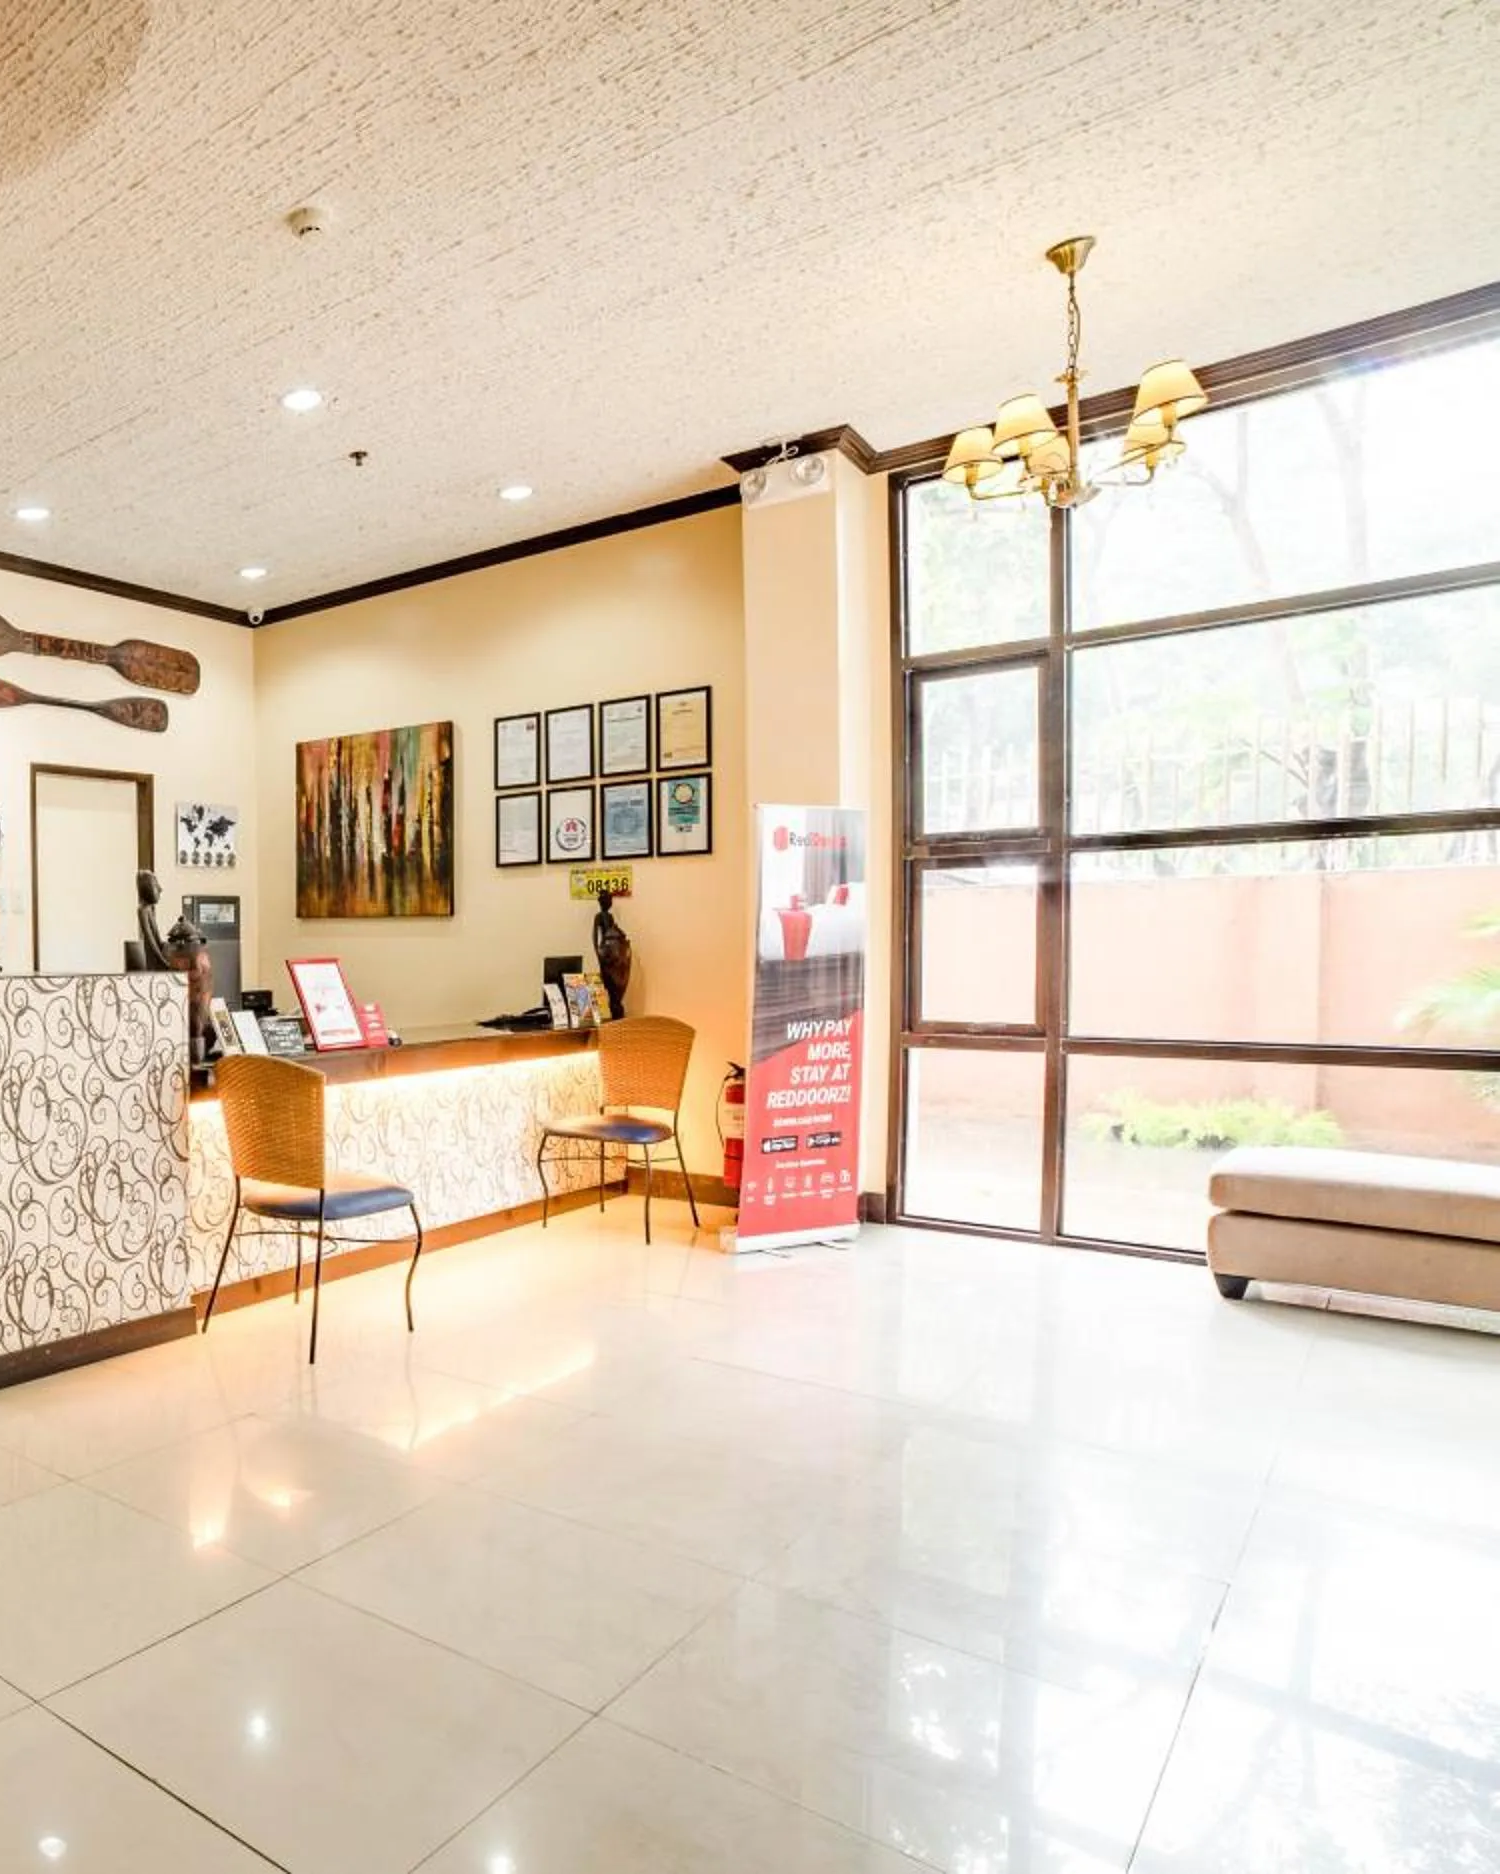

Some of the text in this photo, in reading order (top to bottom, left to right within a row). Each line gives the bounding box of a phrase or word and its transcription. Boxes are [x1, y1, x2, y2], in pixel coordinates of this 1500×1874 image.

[786, 1016, 853, 1039] WHY PAY
[790, 1063, 852, 1085] STAY AT
